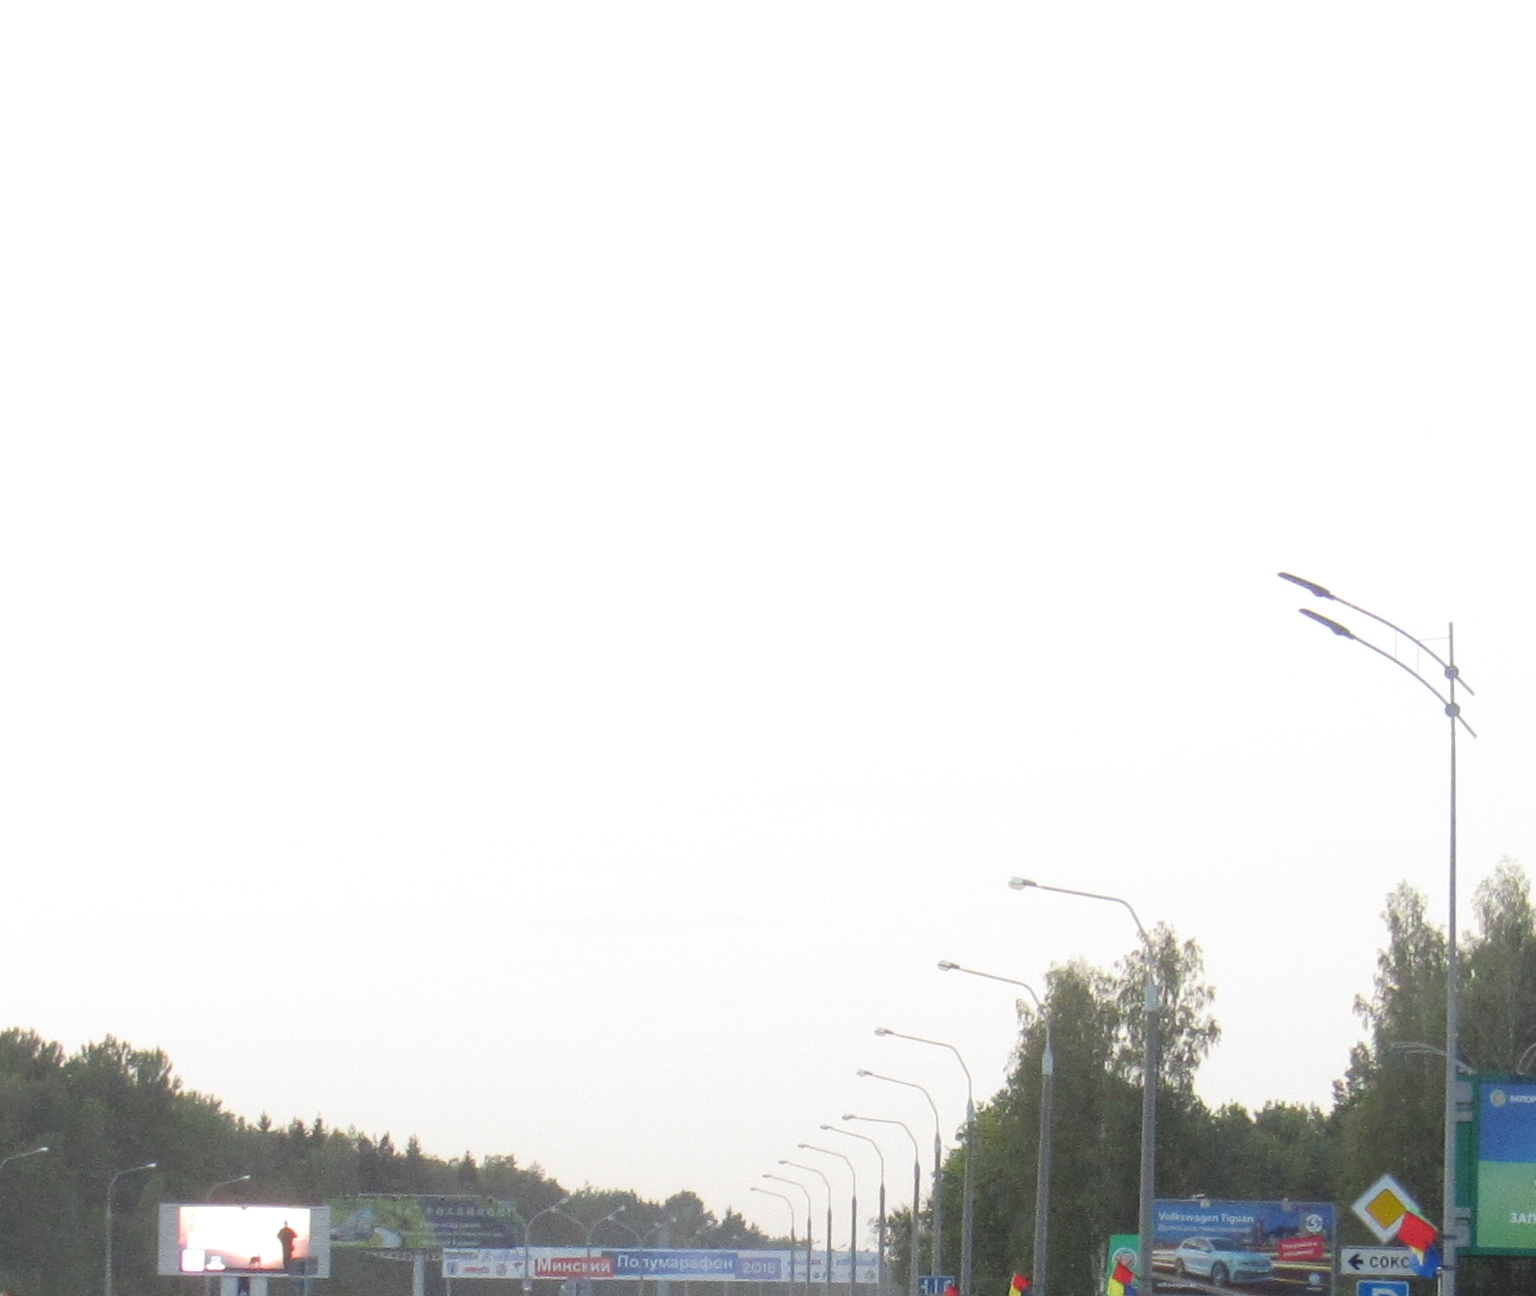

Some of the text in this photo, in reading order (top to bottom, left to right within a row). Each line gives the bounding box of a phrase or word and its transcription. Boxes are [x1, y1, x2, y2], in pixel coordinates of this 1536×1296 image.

[1157, 1210, 1255, 1225] Volkswagen Tiguan
[537, 1257, 611, 1274] Минский
[616, 1253, 733, 1273] Полумарафон
